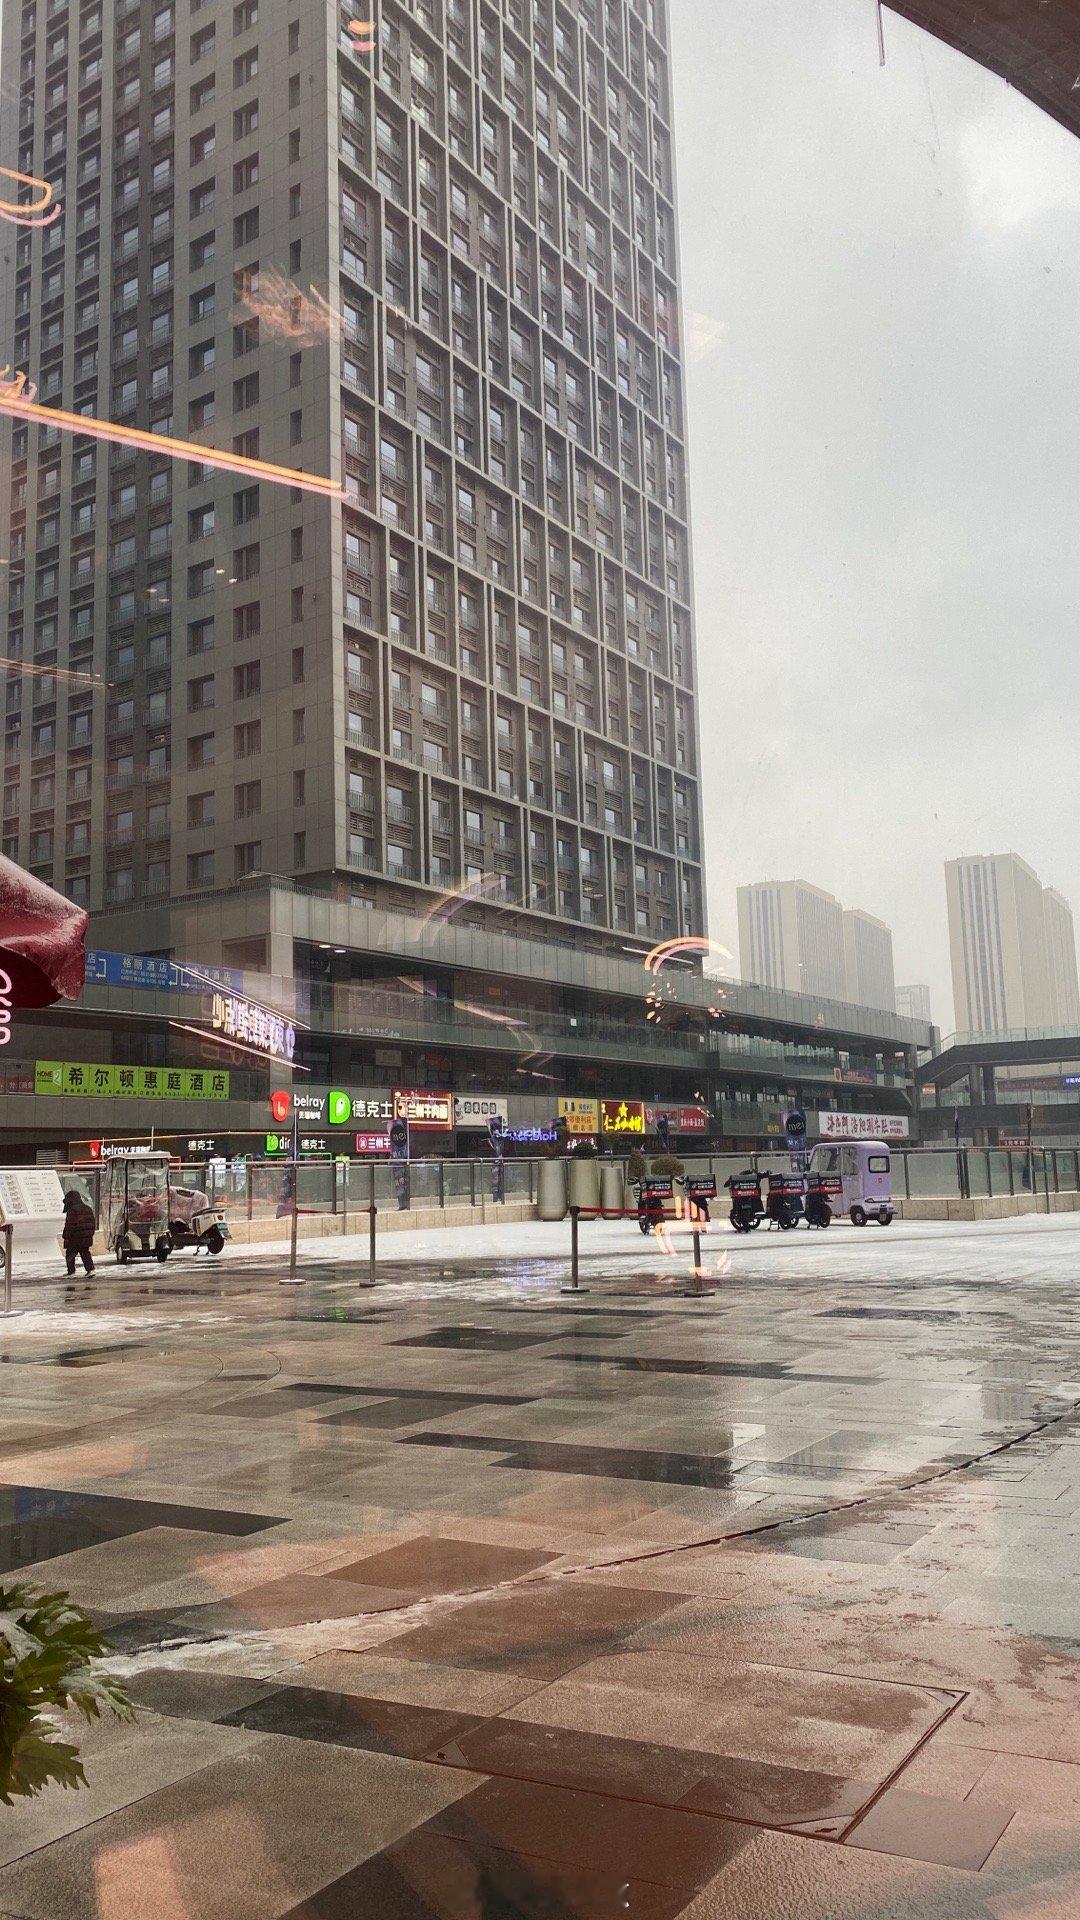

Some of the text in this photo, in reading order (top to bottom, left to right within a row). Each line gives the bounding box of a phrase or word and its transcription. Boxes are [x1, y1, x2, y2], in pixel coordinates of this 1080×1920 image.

[69, 1067, 225, 1091] 希尔顿惠庭酒店
[293, 1094, 326, 1111] belray
[352, 1100, 393, 1118] 德克士
[100, 1144, 130, 1156] belray
[188, 1140, 215, 1151] 德克士
[301, 1139, 326, 1150] 德克士
